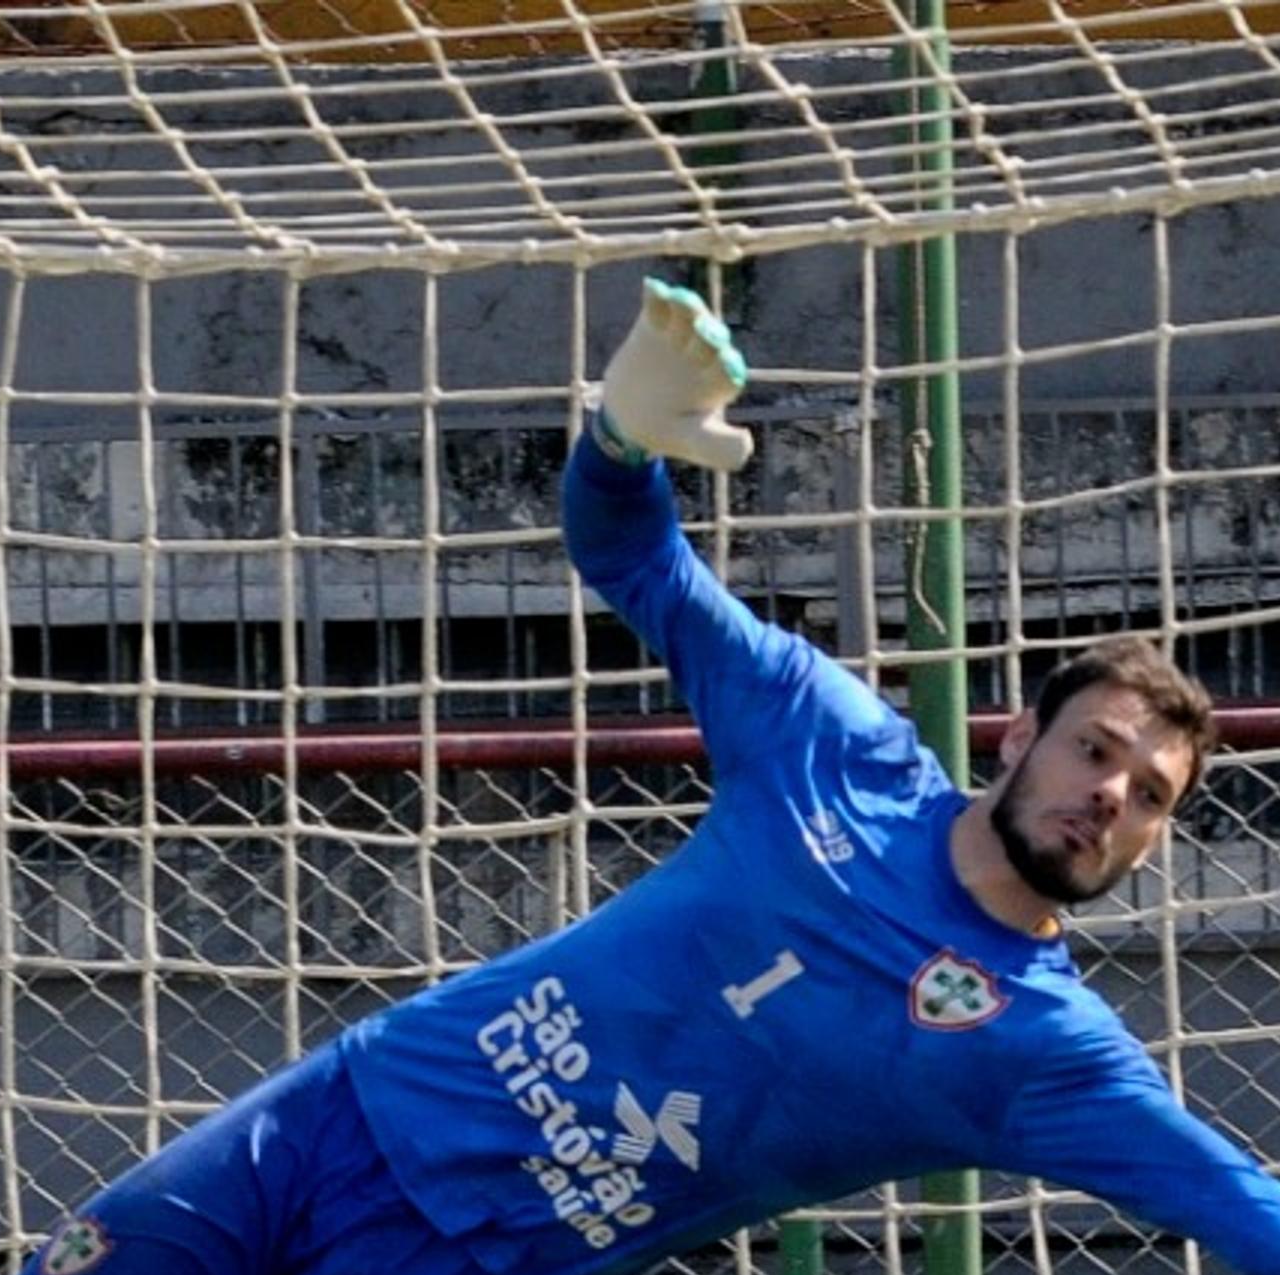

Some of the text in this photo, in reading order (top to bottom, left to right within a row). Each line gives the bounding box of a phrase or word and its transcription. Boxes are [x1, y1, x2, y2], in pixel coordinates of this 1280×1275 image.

[514, 976, 590, 1082] São
[722, 950, 805, 1019] 1
[477, 1010, 655, 1227] Cristóvão
[520, 1155, 615, 1249] saúde
